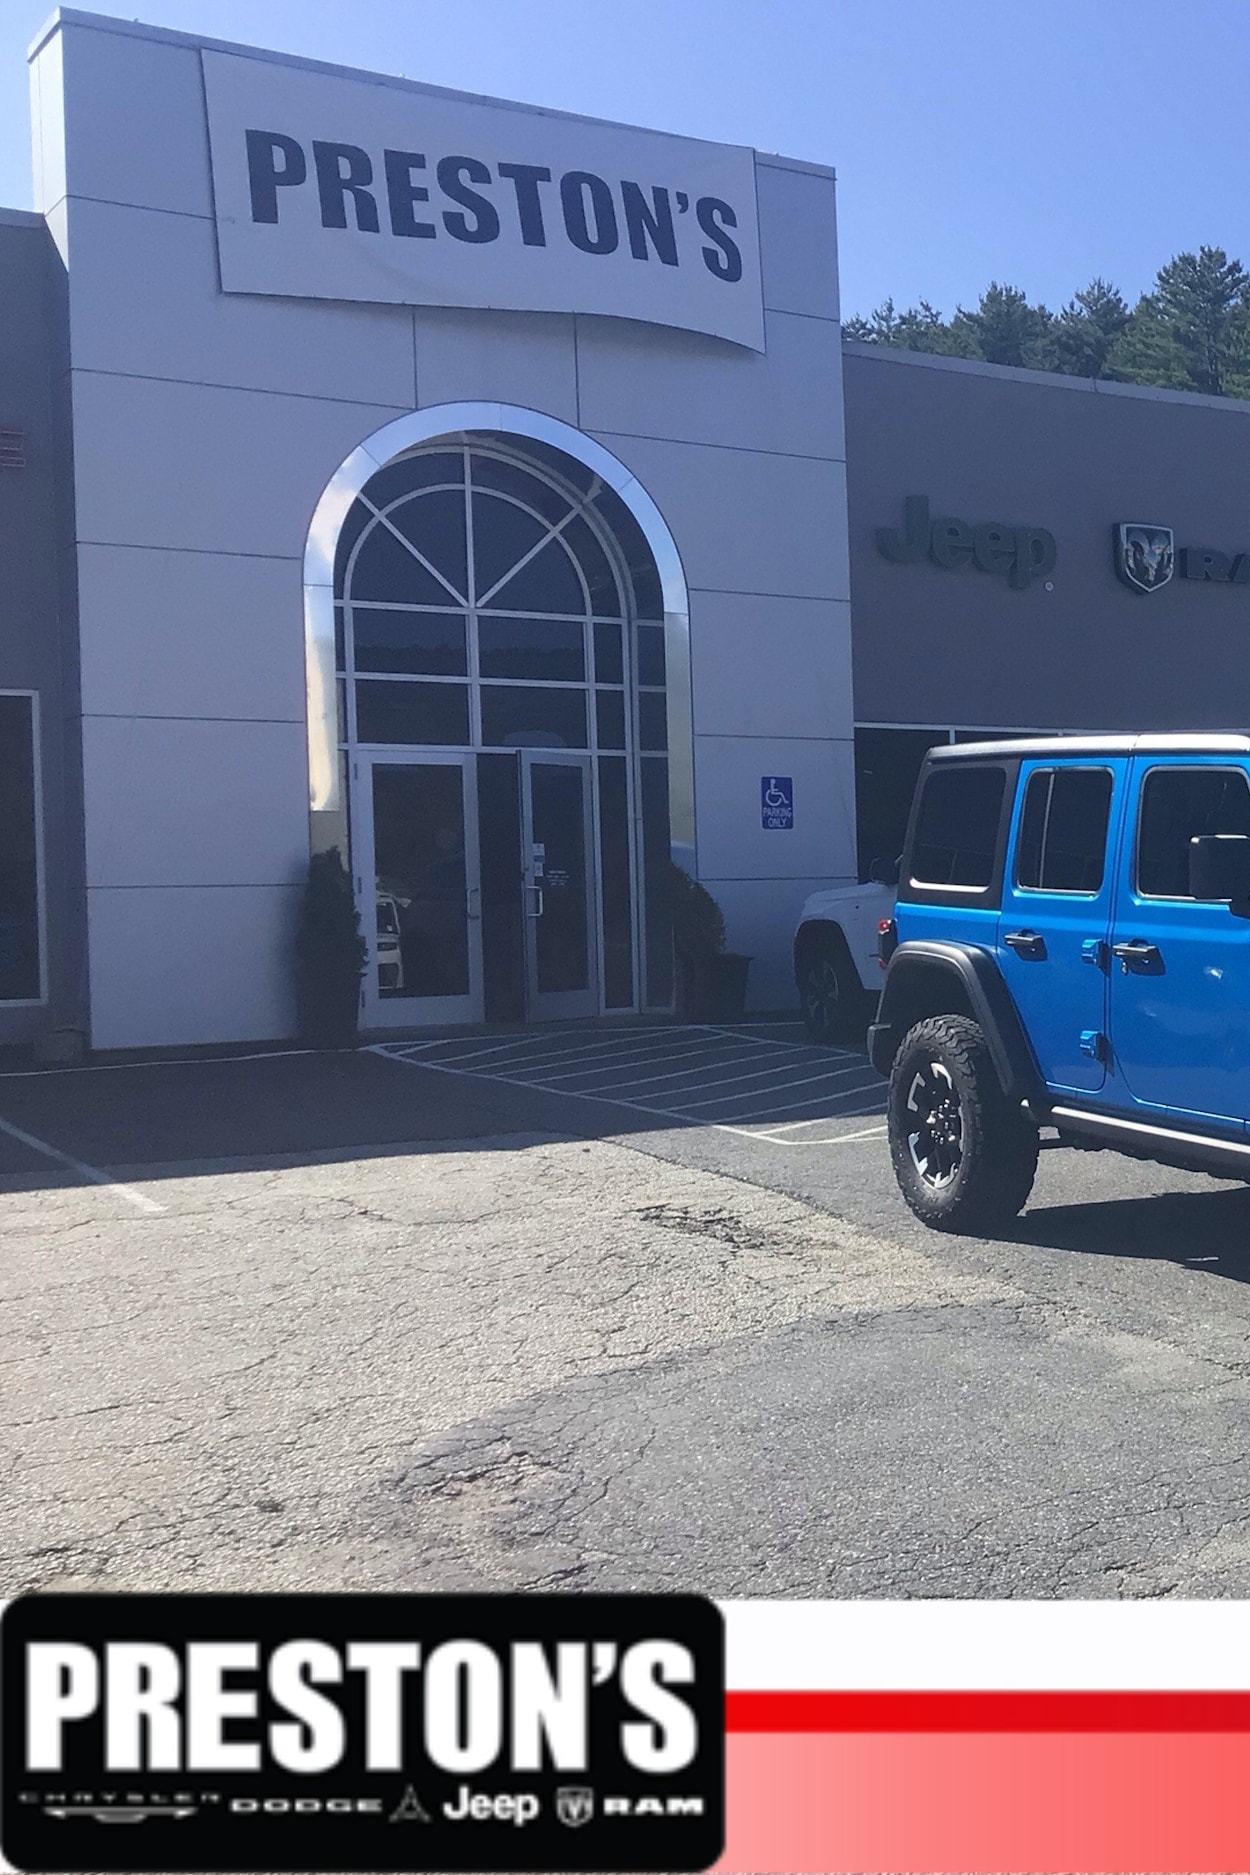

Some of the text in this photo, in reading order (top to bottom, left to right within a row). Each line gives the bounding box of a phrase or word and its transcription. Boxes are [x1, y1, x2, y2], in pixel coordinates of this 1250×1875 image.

[245, 129, 743, 283] PRESTON'S
[875, 494, 1058, 590] Jeep
[763, 807, 792, 818] PARKING
[767, 817, 787, 828] ONLY
